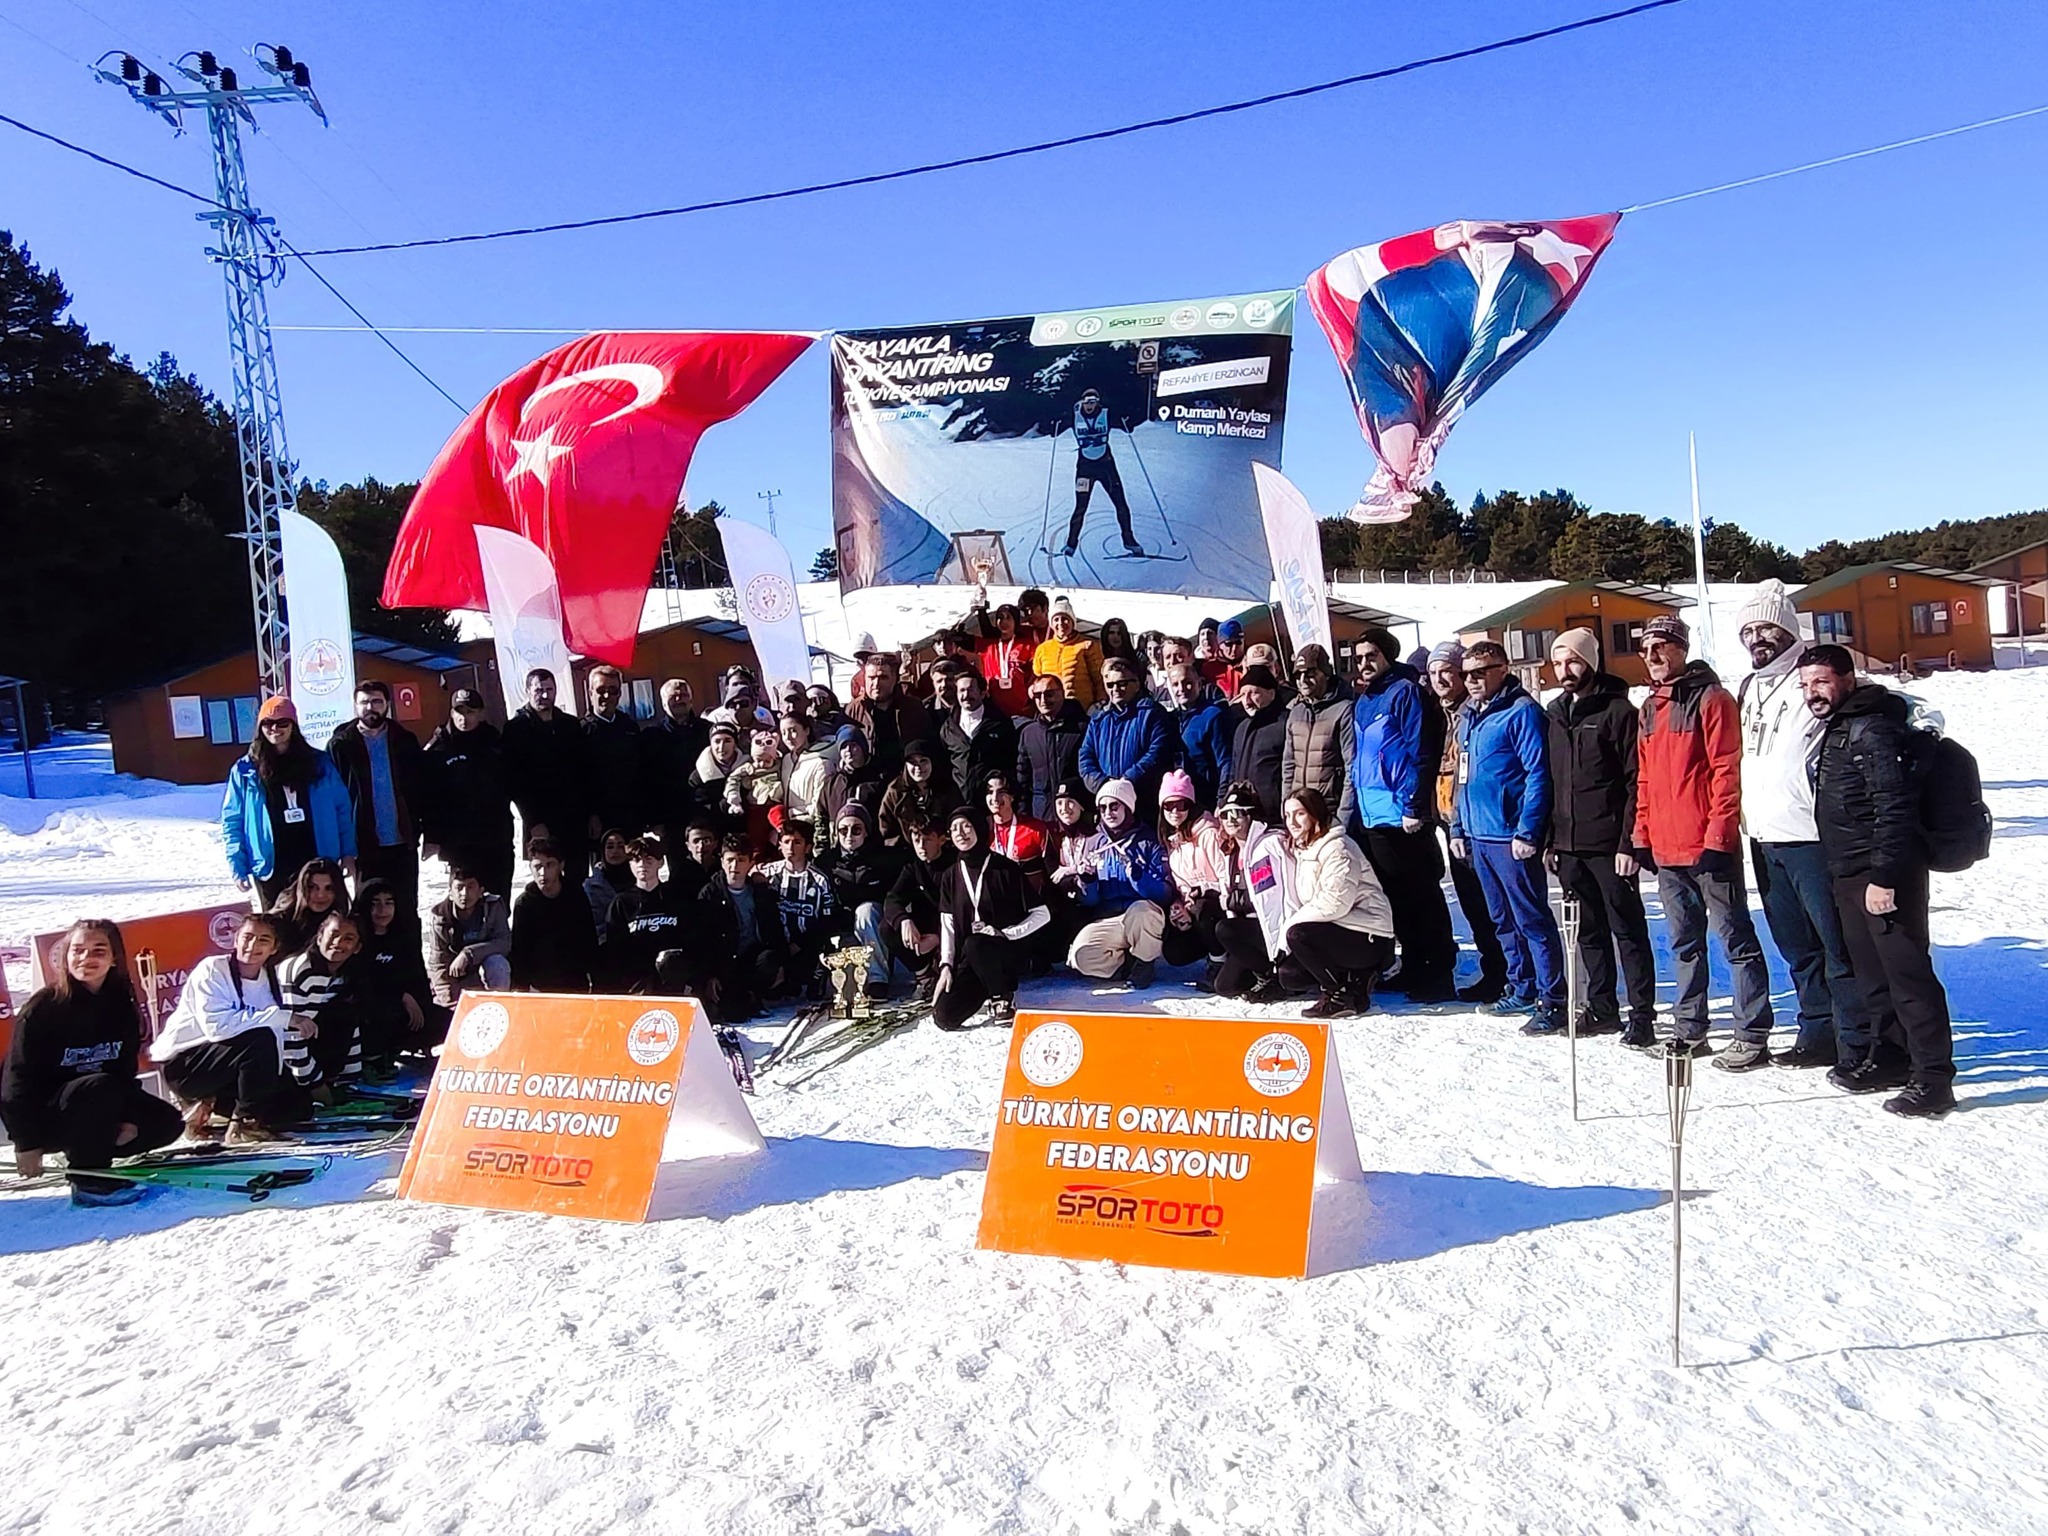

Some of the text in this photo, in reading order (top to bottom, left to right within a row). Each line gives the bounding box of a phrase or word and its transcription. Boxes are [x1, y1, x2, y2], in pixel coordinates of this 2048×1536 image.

[847, 335, 950, 359] KAYAKLA
[1162, 373, 1209, 387] REFAHİYE
[1215, 366, 1264, 380] ERZİNCAN
[1174, 405, 1271, 424] Dumanlı Yaylası
[1177, 421, 1266, 439] Kamp Merkezi
[437, 1065, 673, 1106] TÜRKİYE ORYANTİRİNG
[463, 1106, 620, 1139] FEDERASYONU
[1003, 1095, 1315, 1143] TÜRKİYE ORYANTİRİNG
[1046, 1142, 1251, 1181] FEDERASYONU
